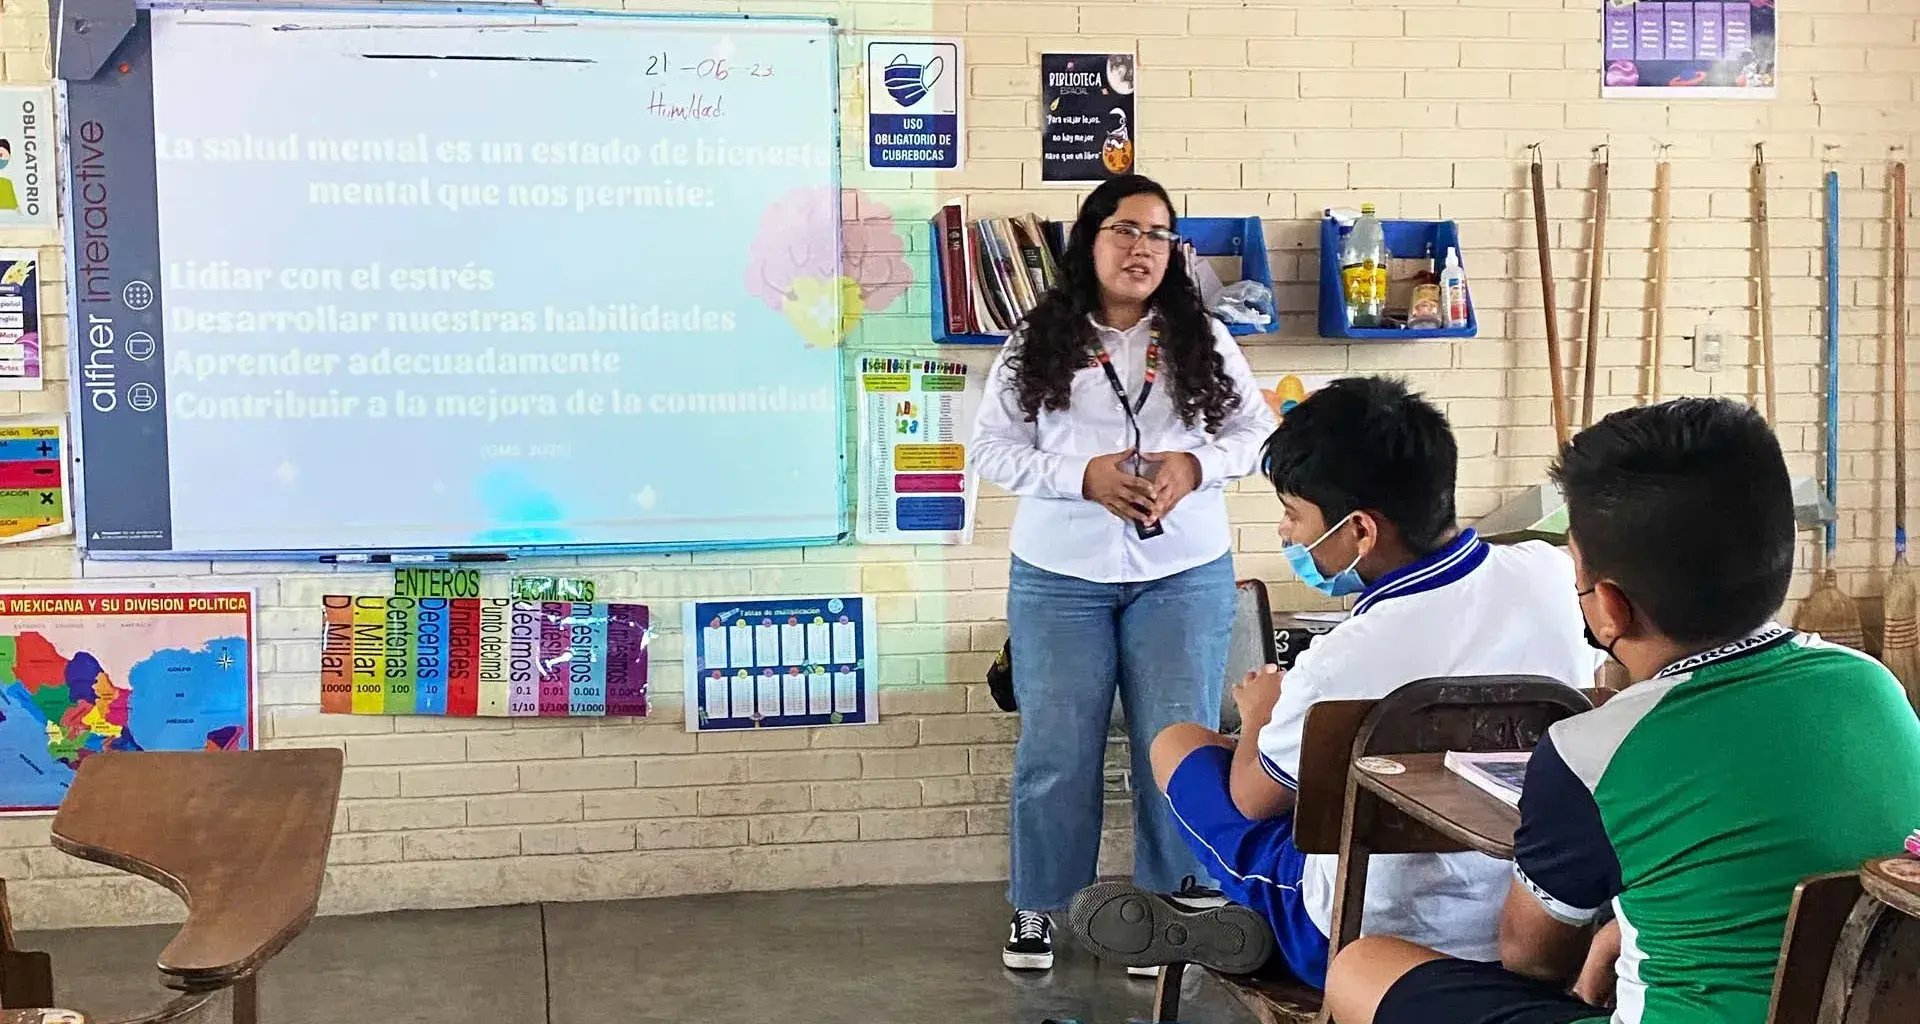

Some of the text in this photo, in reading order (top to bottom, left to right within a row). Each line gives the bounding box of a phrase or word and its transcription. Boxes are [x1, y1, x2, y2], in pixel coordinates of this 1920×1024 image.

[1049, 72, 1102, 87] BIBLIOTECA
[903, 118, 924, 130] USO
[874, 133, 952, 146] OBLIGATORIO DE
[1062, 132, 1074, 143] hay
[23, 100, 39, 216] OBLIGATORIO
[202, 131, 299, 162] salud
[306, 132, 429, 163] mental
[435, 140, 473, 163] es
[479, 140, 524, 165] un
[530, 136, 641, 165] estado
[649, 137, 689, 167] de
[882, 149, 945, 161] CUBREBOCAS
[309, 176, 716, 213] mental que nos permite:
[75, 120, 111, 303] interactive
[170, 259, 496, 292] Lidiar con el estrés
[171, 301, 737, 334] Desarrollar nuestras habilidades
[171, 346, 622, 381] Aprender adecuadamente
[174, 388, 361, 420] Contribuir
[367, 394, 389, 420] a
[394, 389, 429, 420] la
[435, 387, 559, 422] mejora
[565, 388, 606, 417] de
[611, 388, 642, 416] la
[32, 428, 55, 438] Signo
[394, 568, 480, 598] ENTEROS
[11, 598, 84, 613] MEXICANA
[88, 598, 97, 612] Y
[101, 598, 120, 612] SU
[124, 595, 184, 612] DIVISIÓN
[385, 596, 416, 679] Centenas
[416, 597, 448, 679] Decenas
[448, 598, 480, 680] Unidades
[480, 598, 510, 683] Punto decimal
[510, 601, 540, 683] décimos
[321, 623, 352, 677] Millar
[353, 624, 384, 677] Millar
[322, 685, 352, 693] 10000
[357, 685, 381, 693] 1000
[391, 685, 410, 693] 100
[425, 686, 438, 694] 10
[516, 687, 532, 695] 0.1
[543, 687, 565, 696] 0.01
[573, 688, 601, 696] 0.001
[512, 702, 536, 713] 1/10
[539, 703, 569, 713] 1/100
[570, 703, 605, 713] 1/1000
